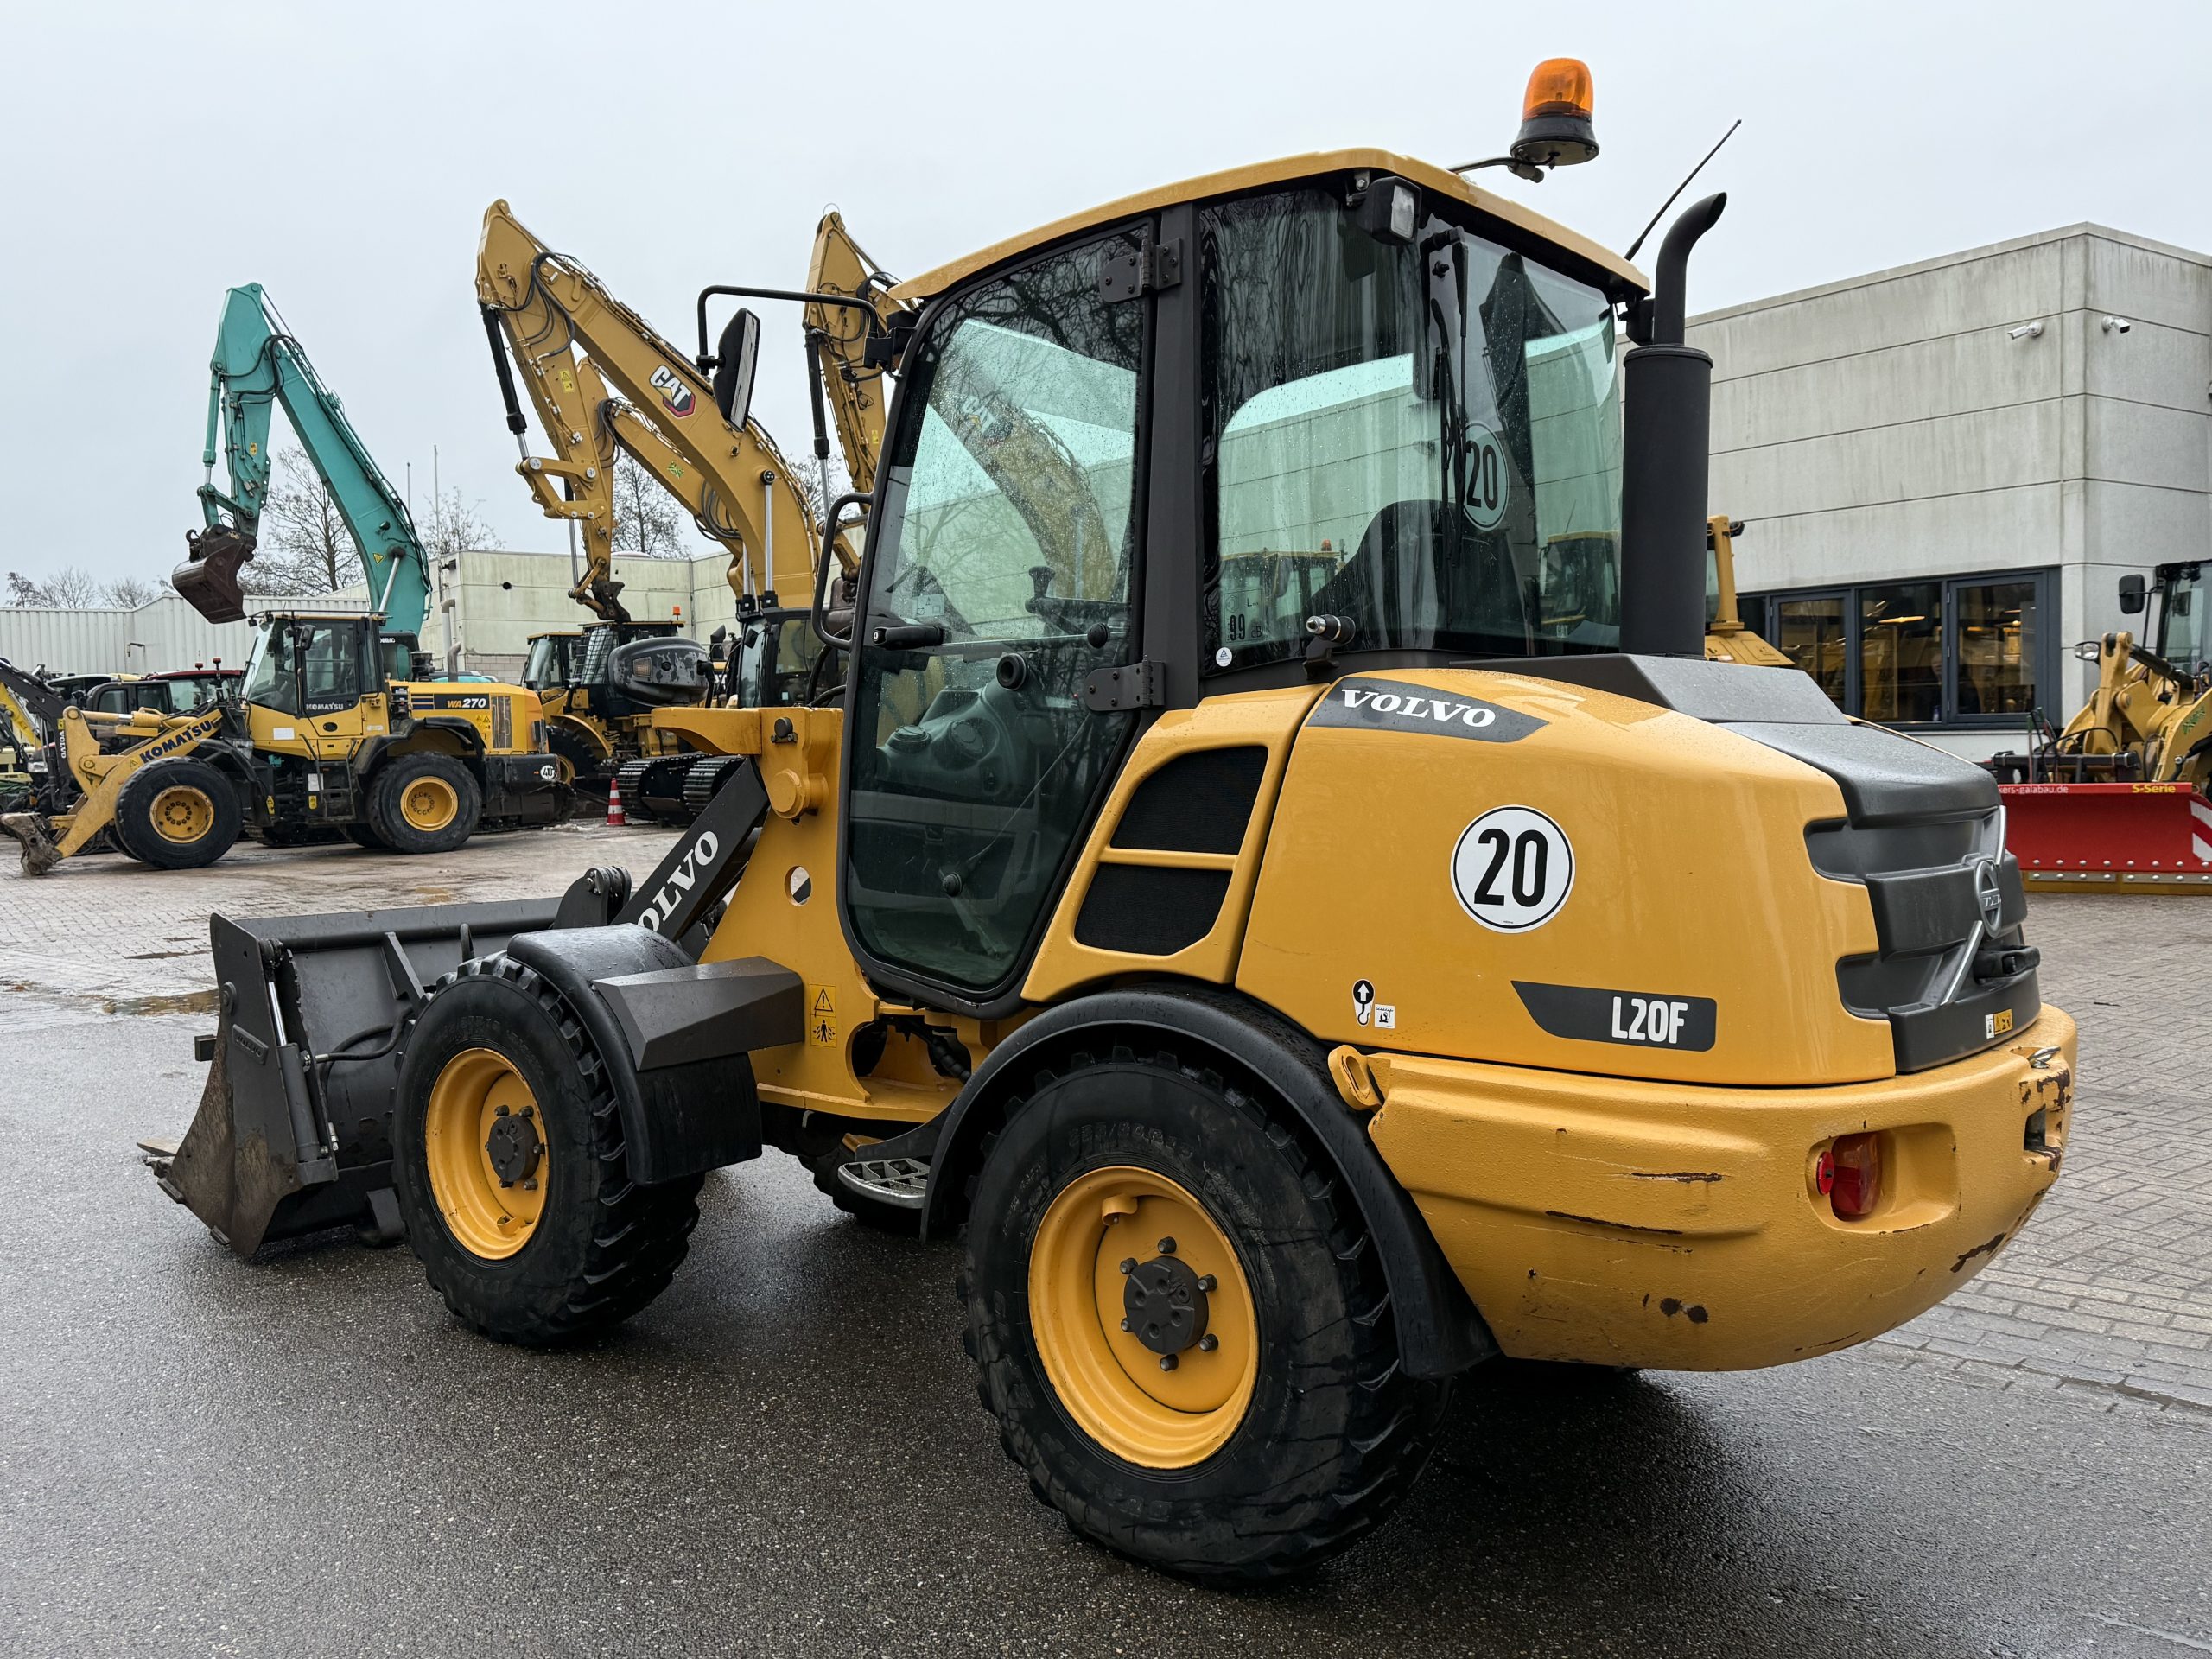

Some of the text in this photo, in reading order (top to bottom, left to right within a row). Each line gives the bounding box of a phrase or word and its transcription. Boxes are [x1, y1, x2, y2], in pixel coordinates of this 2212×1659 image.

[650, 365, 691, 407] CAT
[1465, 440, 1498, 511] 20
[1230, 613, 1245, 641] 99
[1251, 626, 1262, 639] dB
[447, 698, 486, 709] WA270
[1341, 689, 1496, 728] VOLVO
[140, 720, 213, 763] KOMATSU
[638, 830, 719, 932] OLVO
[1473, 828, 1548, 907] 20
[1611, 996, 1688, 1044] L20F
